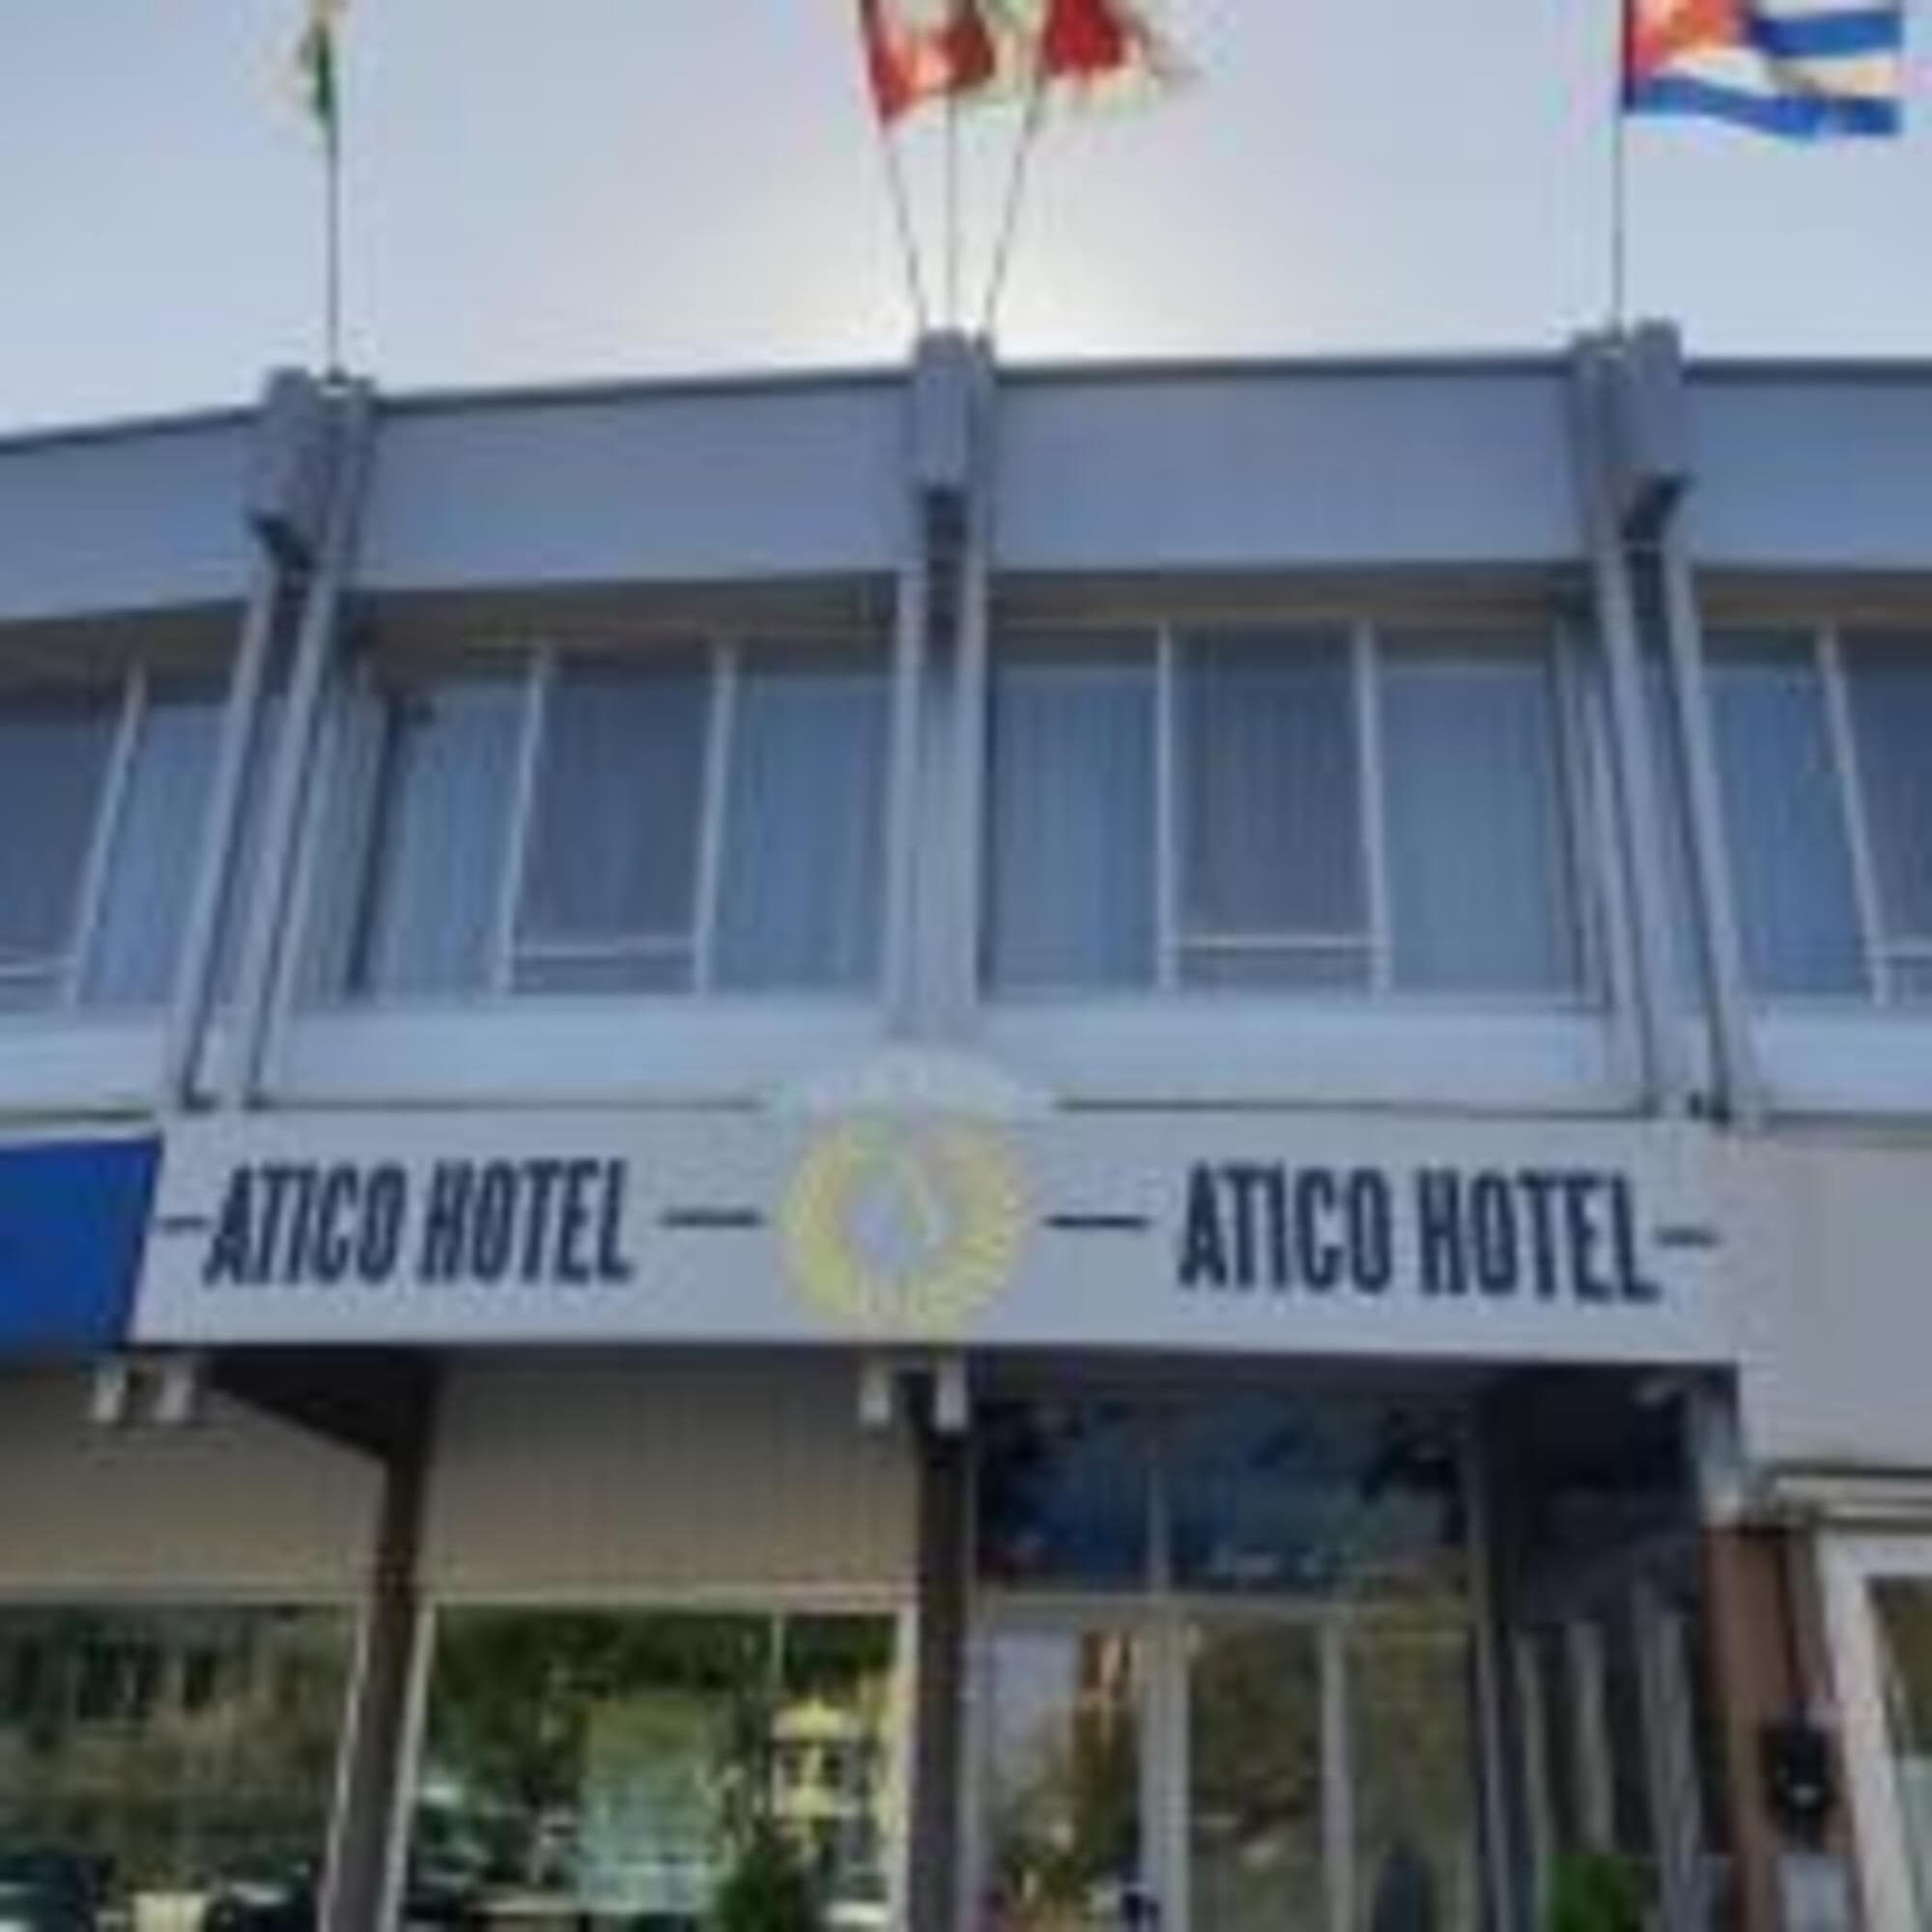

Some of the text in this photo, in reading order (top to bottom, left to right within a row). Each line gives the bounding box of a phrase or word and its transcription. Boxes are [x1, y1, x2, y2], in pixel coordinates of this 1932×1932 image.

[203, 1159, 634, 1286] ATICO HOTEL
[1178, 1162, 1661, 1302] ATICO HOTEL
